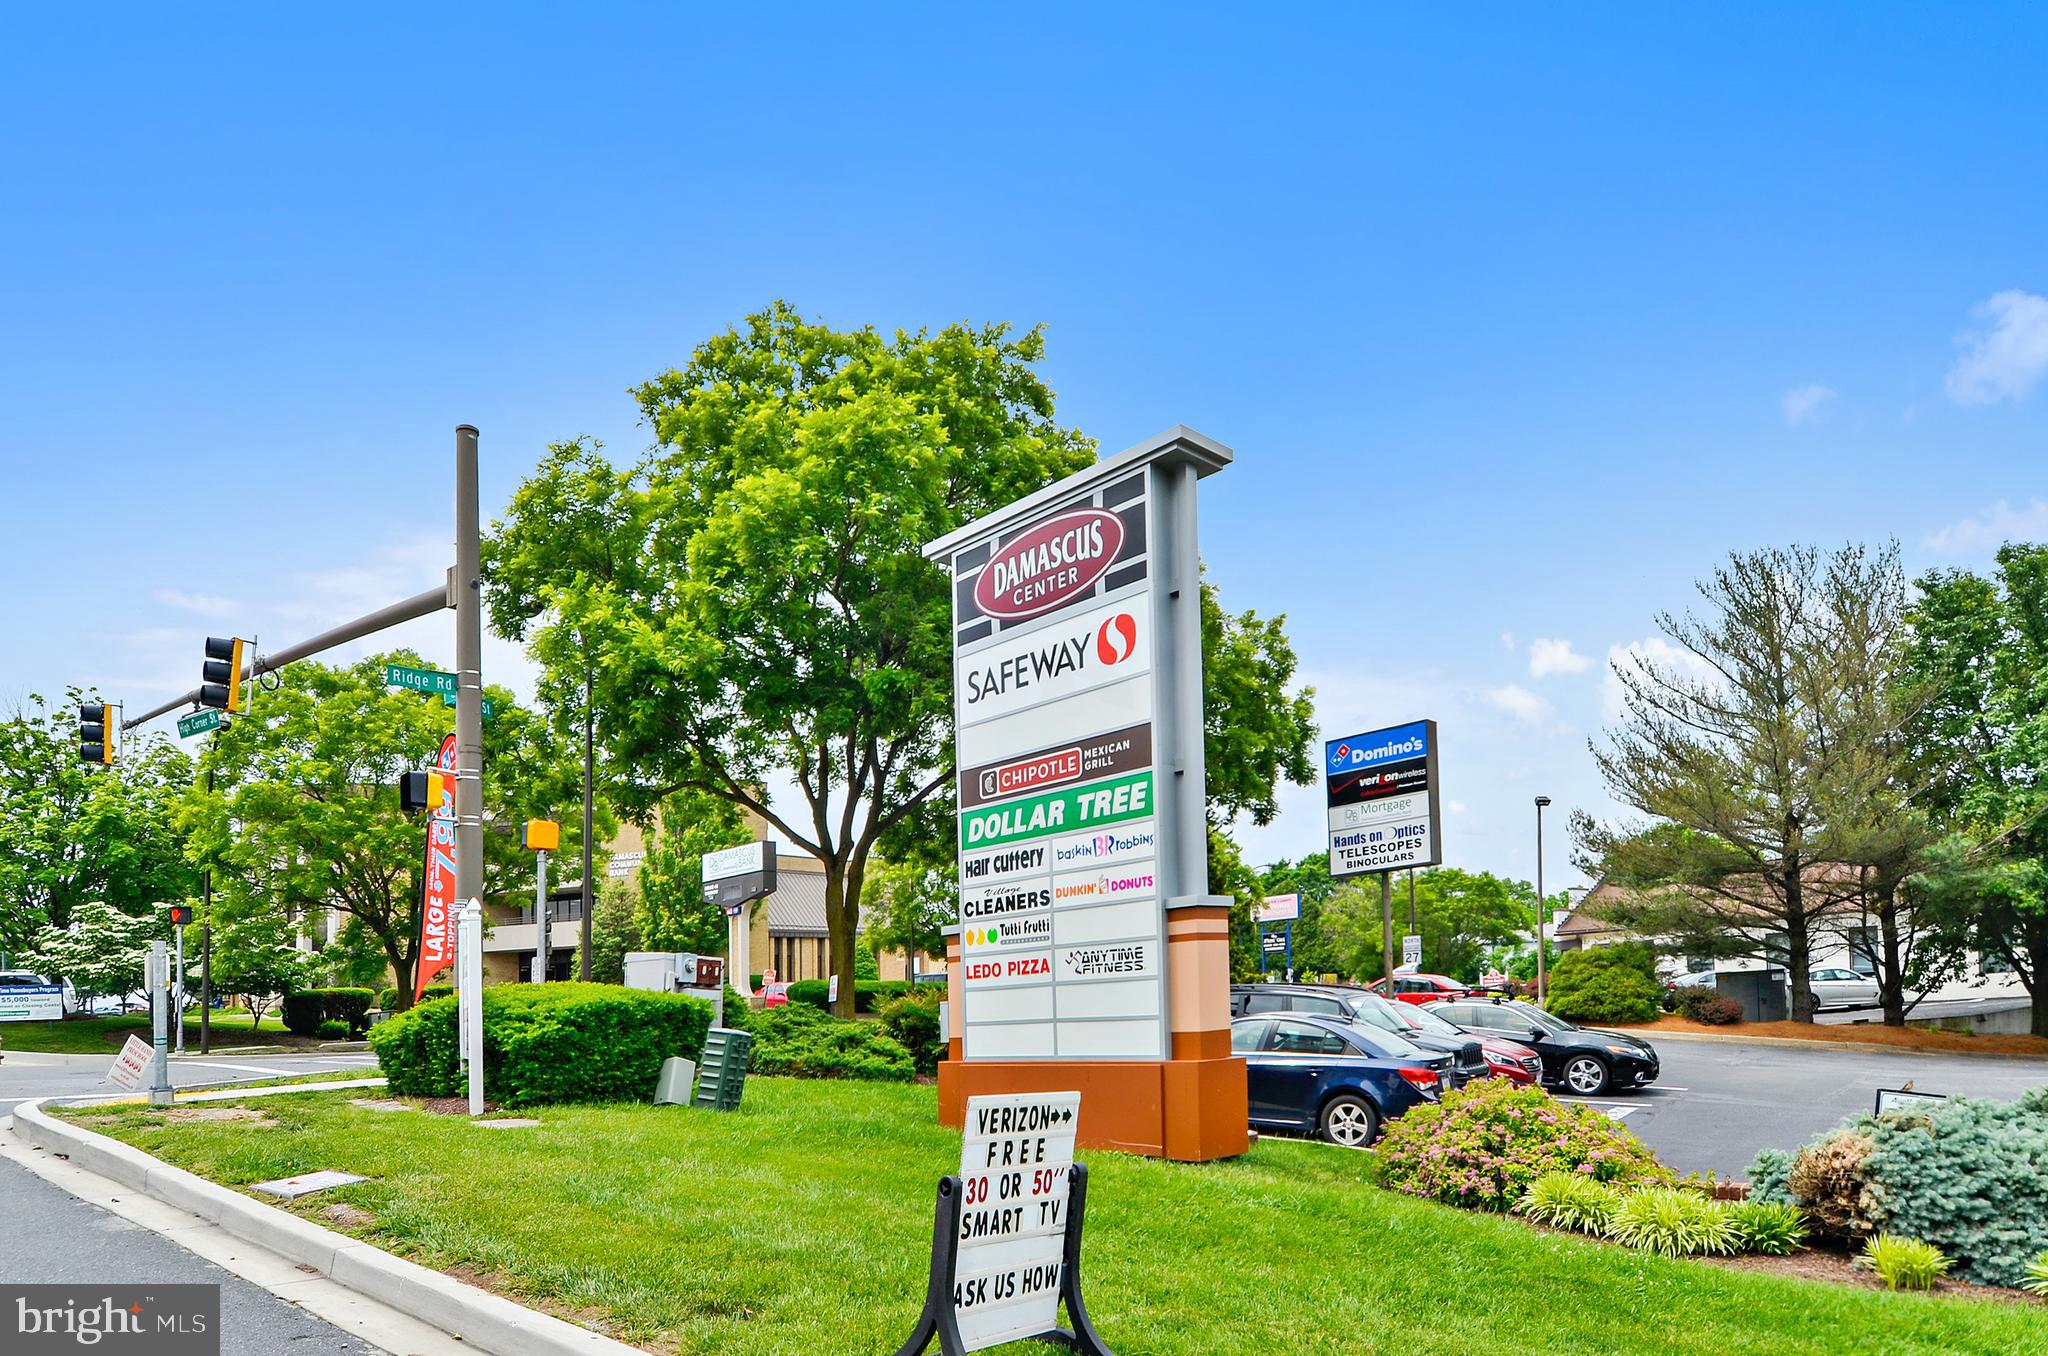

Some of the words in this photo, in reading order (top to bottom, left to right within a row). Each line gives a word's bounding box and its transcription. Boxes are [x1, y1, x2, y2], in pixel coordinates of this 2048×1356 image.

[993, 519, 1103, 599] DAMASCUS
[1013, 567, 1079, 605] CENTER
[968, 632, 1091, 704] SAFEWAY
[393, 669, 429, 688] Ridge
[437, 676, 452, 690] Rd
[482, 702, 491, 714] St
[179, 722, 191, 735] High
[191, 717, 208, 729] Corner
[209, 712, 218, 724] St
[1084, 740, 1130, 760] MEXICAN
[1352, 736, 1423, 764] Domino's
[1001, 756, 1077, 787] CHIPOTLE
[1084, 756, 1114, 771] GRILL
[1359, 771, 1398, 787] verizon
[1398, 768, 1427, 780] wireless
[968, 799, 1065, 843] DOLLAR
[1077, 781, 1148, 821] TREE
[1360, 798, 1412, 815] Mortgage
[1334, 832, 1366, 848] Hands
[1369, 831, 1383, 842] on
[1339, 838, 1422, 859] TELESCOPES
[609, 851, 647, 861] AMASCU
[719, 846, 756, 862] DAMASCUS
[965, 857, 990, 878] Hair
[993, 847, 1044, 873] cuttery
[1346, 851, 1414, 869] BINOCULARS
[609, 868, 629, 877] BANK
[983, 885, 1021, 898] Village
[1055, 883, 1097, 899] DUNKIN'
[1111, 875, 1153, 892] DONUTS
[964, 889, 1050, 918] CLEANERS
[425, 895, 445, 961] LARGE
[1000, 921, 1021, 936] Tutti
[1082, 946, 1143, 963] ANYTIME
[1405, 952, 1419, 963] 27
[966, 962, 1002, 979] LEDO
[1008, 958, 1050, 976] PIZZA
[1082, 960, 1144, 974] FITNESS
[978, 1104, 1050, 1134] VERIZON
[987, 1138, 1045, 1168] FREE
[966, 1176, 988, 1205] 30
[1000, 1172, 1021, 1200] OR
[960, 1207, 1023, 1240] SMART
[1040, 1200, 1061, 1226] TV
[954, 1277, 987, 1308] ASK
[994, 1271, 1015, 1300] US
[1022, 1264, 1059, 1294] HOW
